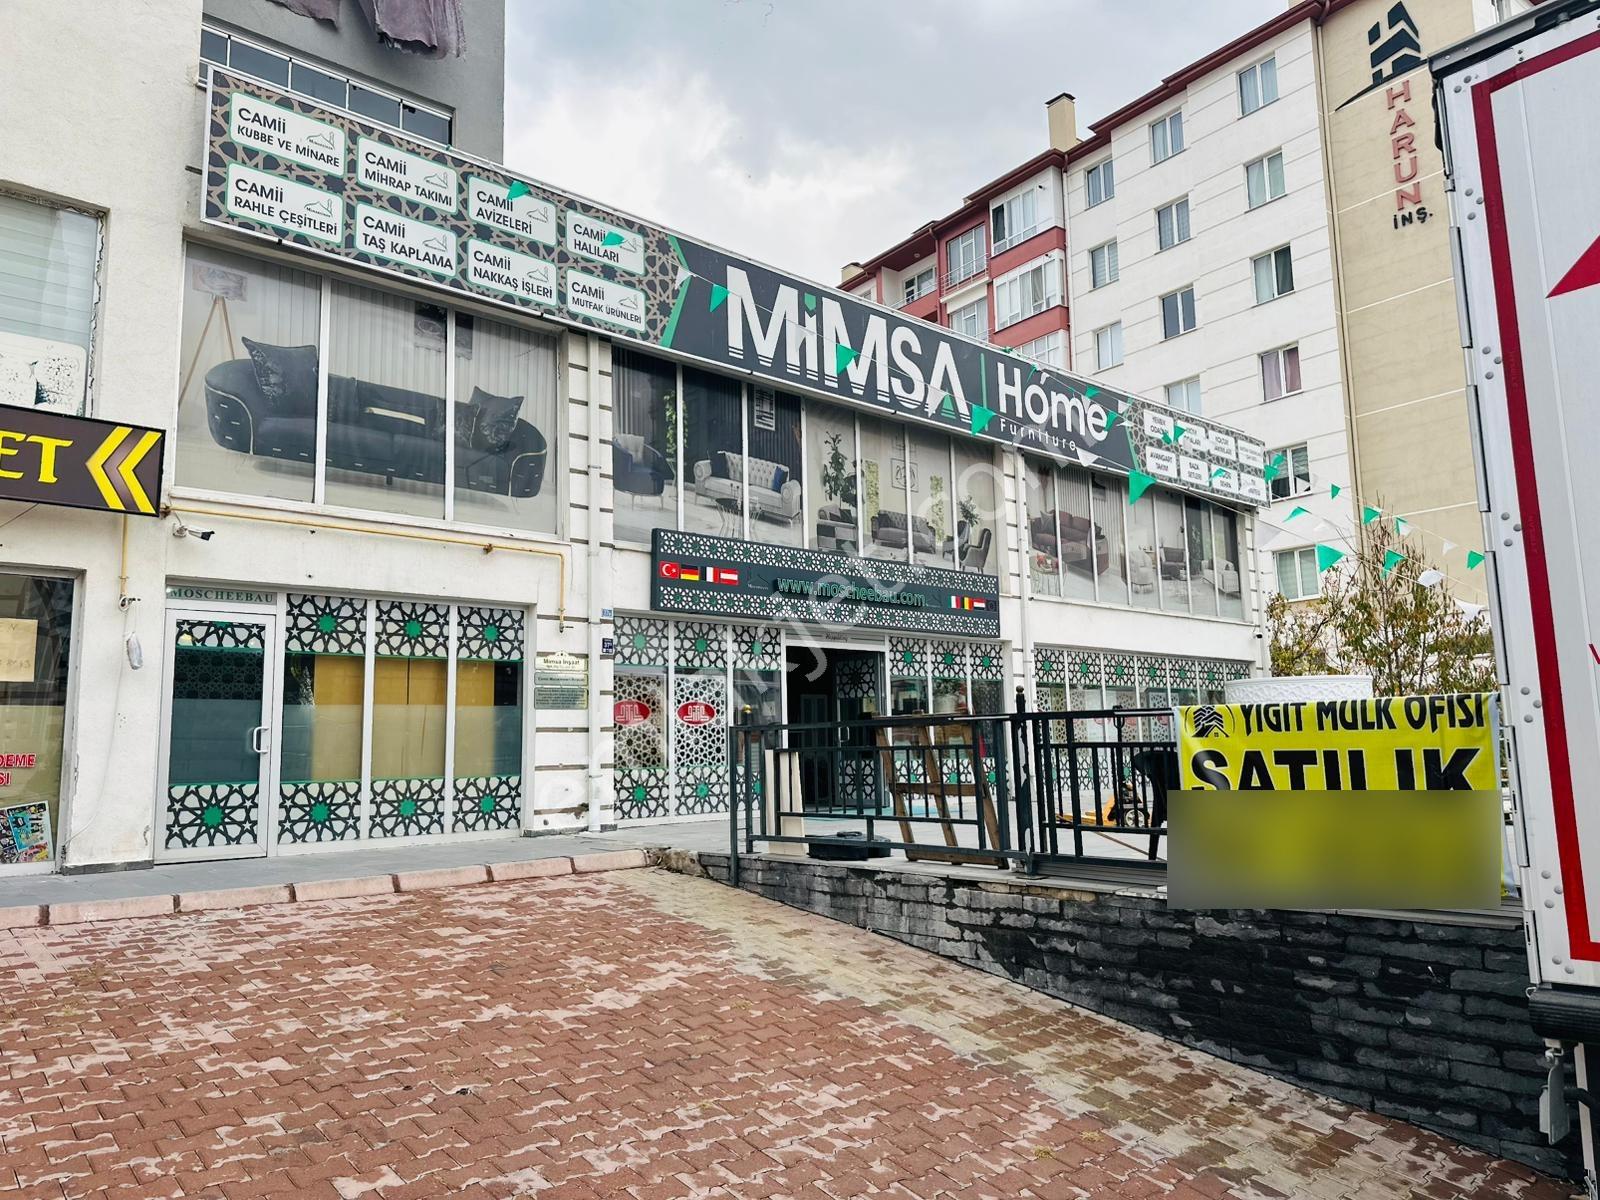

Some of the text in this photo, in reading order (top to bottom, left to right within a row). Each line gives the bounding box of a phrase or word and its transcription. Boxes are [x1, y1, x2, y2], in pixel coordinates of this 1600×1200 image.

[237, 125, 274, 145] KUBBE
[277, 138, 292, 152] VE
[295, 144, 340, 167] MİNARE
[1386, 79, 1422, 211] HARUN
[364, 168, 411, 192] MİHRAP
[414, 184, 452, 207] TAKIMI
[234, 196, 275, 217] RAHLE
[279, 209, 337, 236] ÇEŞİTLERİ
[475, 207, 532, 235] AVİZELERİ
[362, 232, 453, 271] TAŞ KAPLAMA
[574, 239, 619, 263] HALILARI
[473, 266, 553, 299] NAKKAŞ İŞLERİ
[571, 296, 604, 313] MUTFAK
[1000, 418, 1076, 451] Furniture
[0, 430, 74, 484] ET
[170, 588, 273, 603] MOSCHEEBAU
[777, 577, 926, 607] www.moscheebau.com
